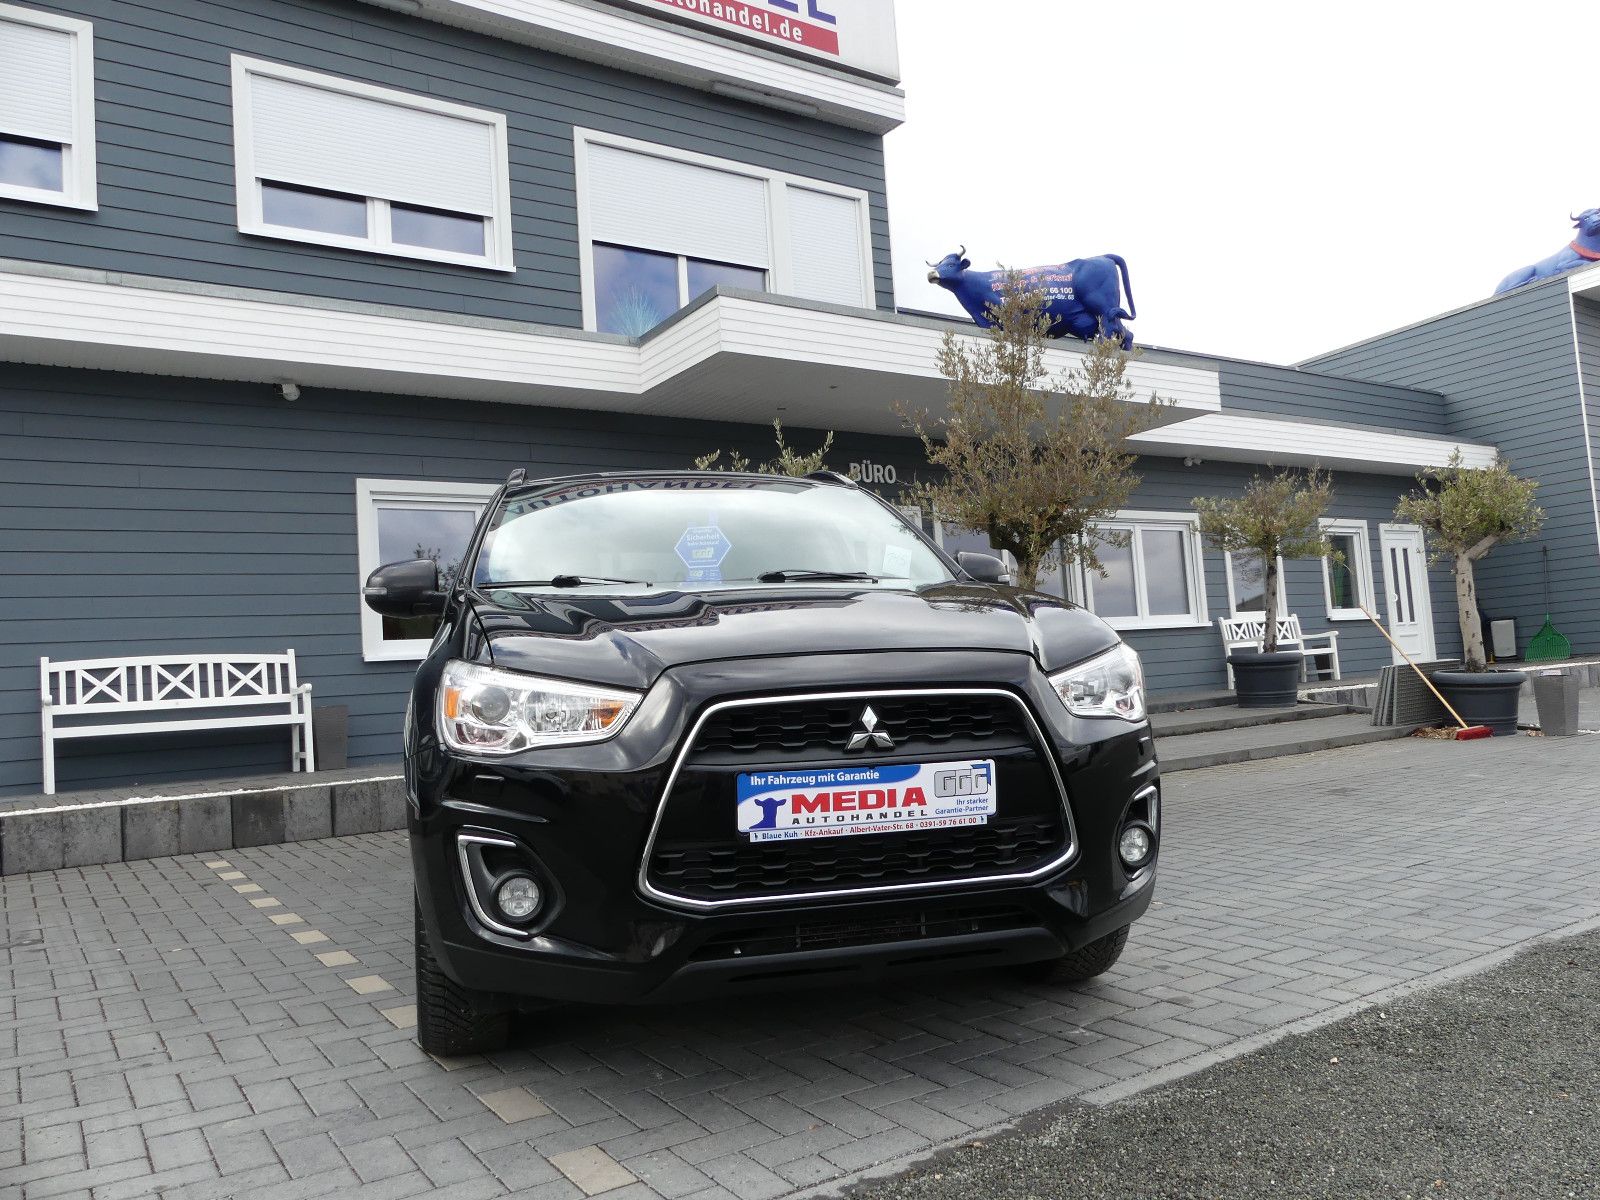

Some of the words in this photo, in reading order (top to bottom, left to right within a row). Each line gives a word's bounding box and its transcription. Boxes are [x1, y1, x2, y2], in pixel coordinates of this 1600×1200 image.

[849, 460, 897, 484] BÜRO
[750, 776, 766, 786] Ihr
[767, 774, 816, 786] Fahrzeug
[818, 772, 835, 783] mit
[836, 770, 880, 781] Garantie
[791, 787, 927, 814] MEDIA
[791, 809, 928, 825] AUTOHANDEL
[935, 805, 988, 815] Garantie-Partner
[762, 831, 782, 840] Blaue
[784, 830, 798, 839] Kuh
[804, 828, 844, 837] Kfz-Ankauf
[849, 823, 904, 834] Albert-Vater-Str.
